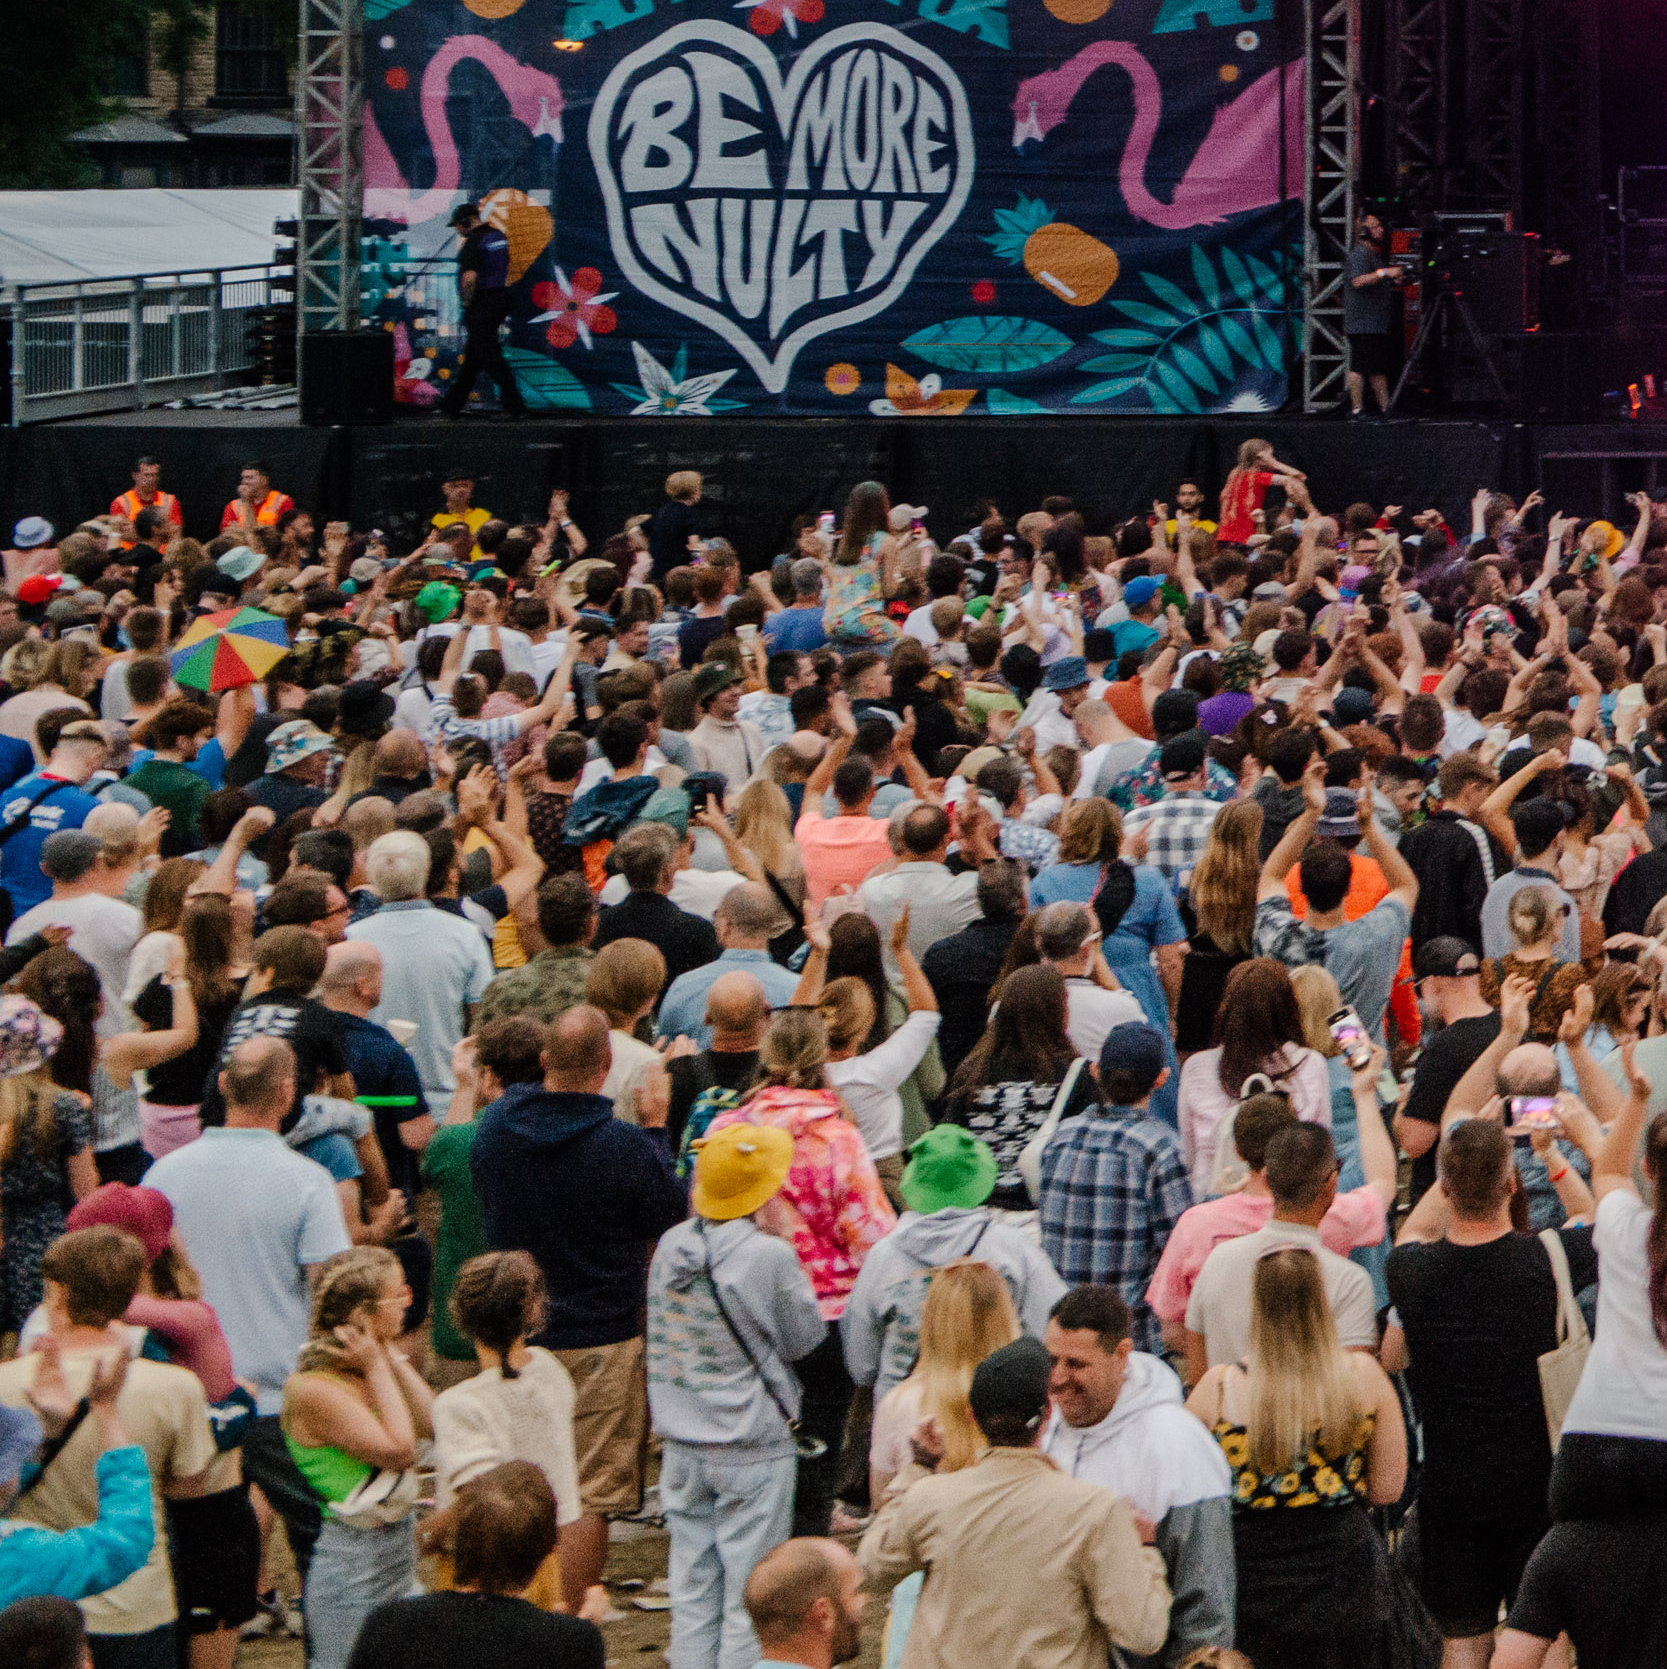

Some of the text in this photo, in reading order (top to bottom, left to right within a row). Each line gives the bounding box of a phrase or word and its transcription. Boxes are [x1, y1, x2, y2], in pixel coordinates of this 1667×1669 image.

[618, 48, 952, 194] BE MORE
[631, 198, 929, 340] NULTY
